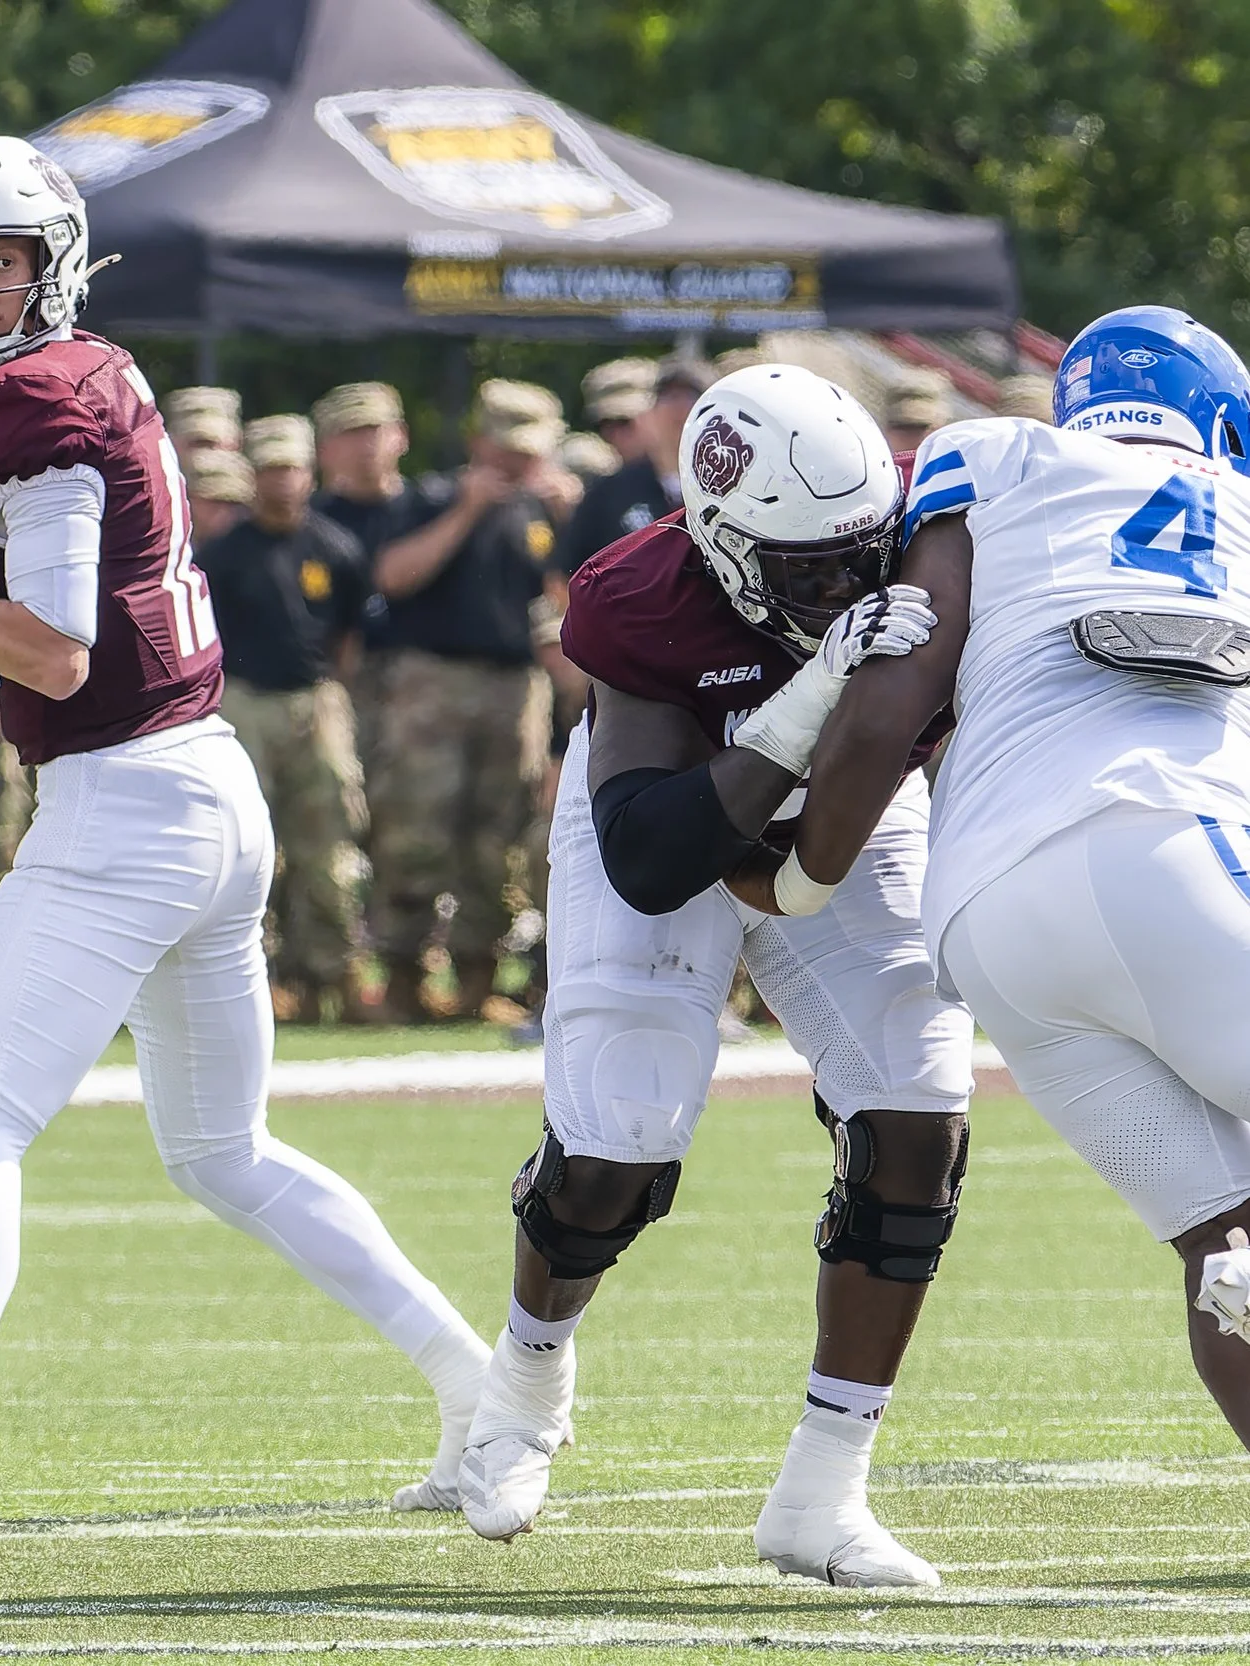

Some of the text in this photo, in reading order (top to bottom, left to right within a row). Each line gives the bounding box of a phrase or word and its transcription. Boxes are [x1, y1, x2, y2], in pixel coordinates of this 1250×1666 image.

[1125, 353, 1152, 363] ACC
[1067, 409, 1164, 432] USTANGS
[833, 513, 874, 535] BEARS
[1110, 472, 1228, 600] 4
